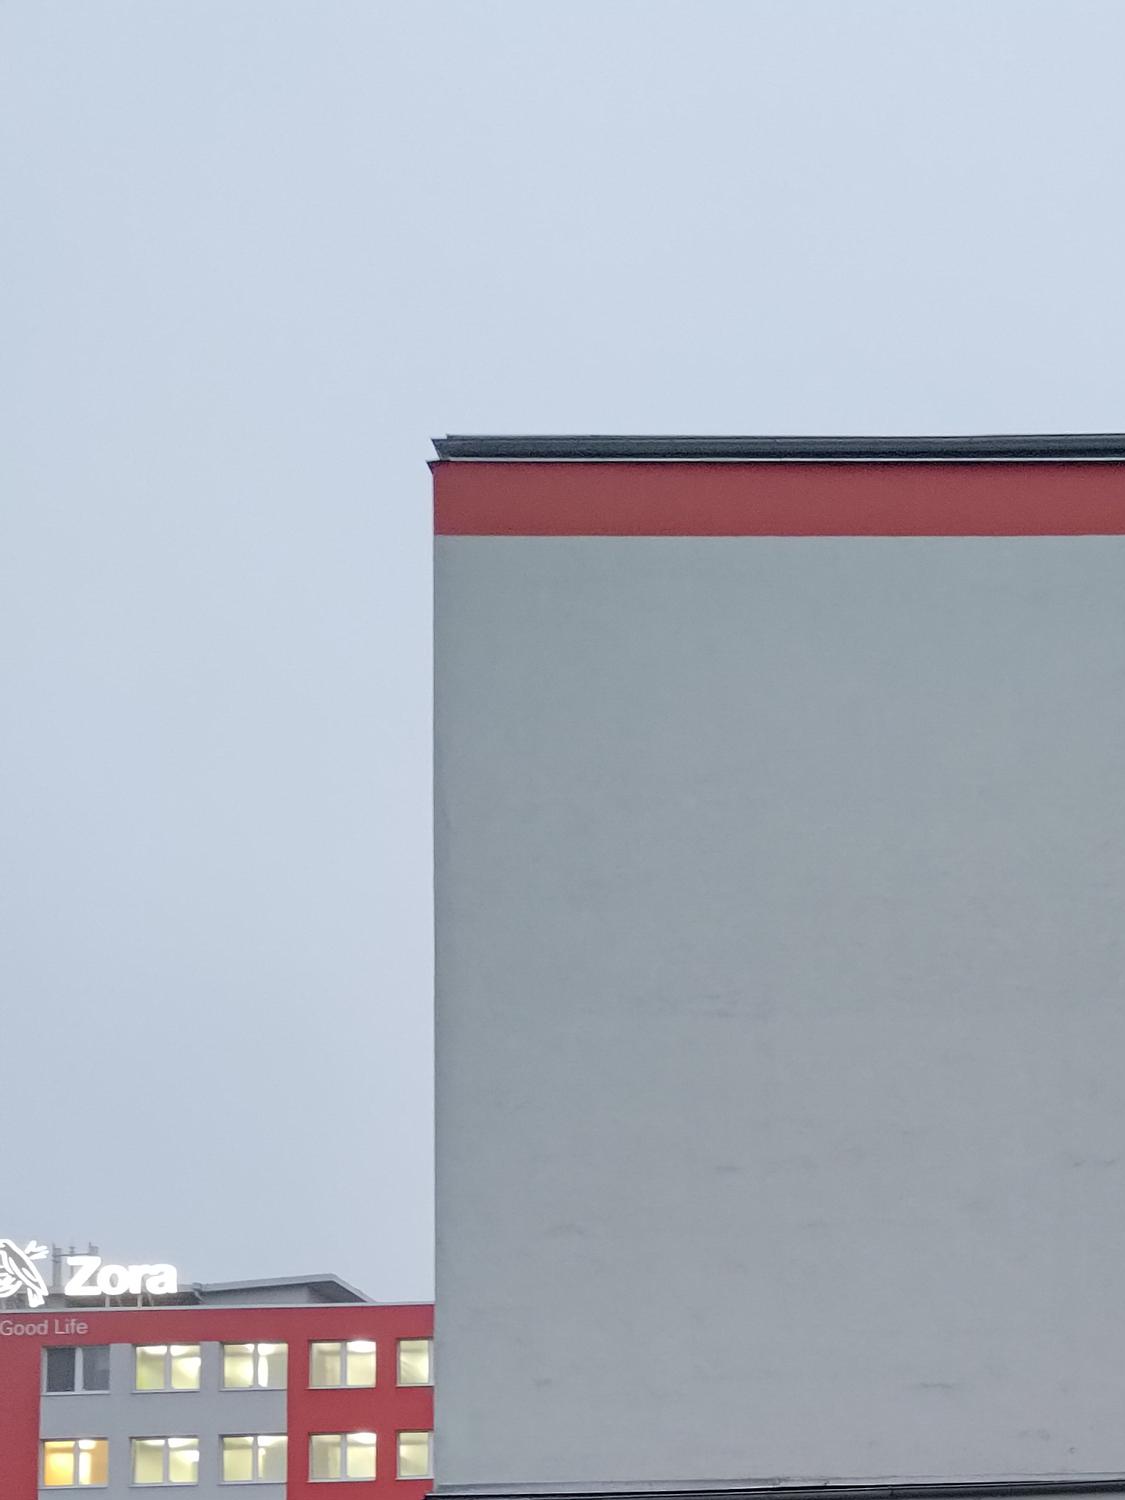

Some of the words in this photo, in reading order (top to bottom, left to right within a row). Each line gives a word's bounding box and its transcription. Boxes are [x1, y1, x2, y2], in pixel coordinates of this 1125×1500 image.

[64, 1255, 178, 1296] Zora
[0, 1320, 49, 1336] Good
[54, 1319, 89, 1335] Life
